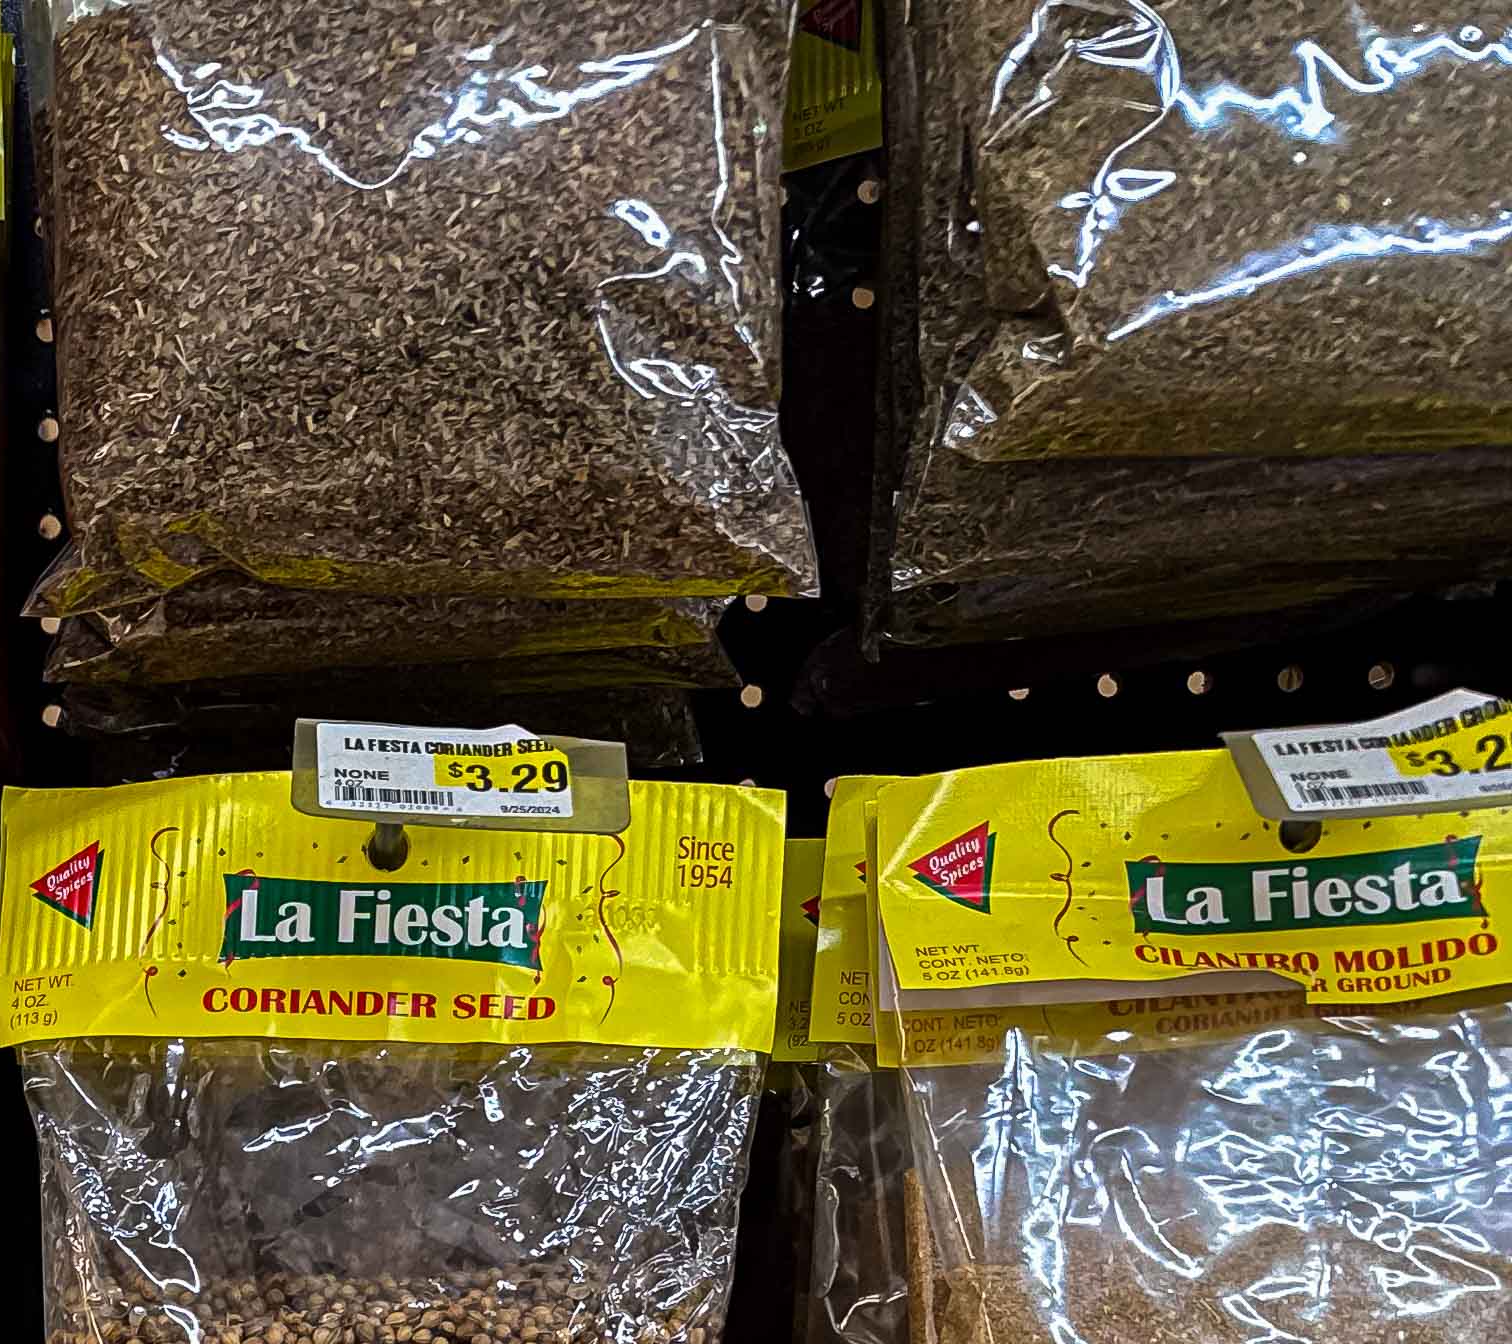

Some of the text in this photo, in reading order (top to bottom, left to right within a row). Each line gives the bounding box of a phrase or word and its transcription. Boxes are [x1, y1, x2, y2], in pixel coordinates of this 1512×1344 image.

[334, 767, 390, 781] NONE
[448, 760, 569, 795] $3.29
[678, 836, 735, 861] Since
[928, 837, 981, 875] Quality
[677, 864, 733, 888] 1954
[938, 856, 985, 887] Spices
[1145, 861, 1468, 925] La Fiesta
[239, 889, 528, 949] La Fiesta
[1134, 933, 1499, 977] CILANTRO MOLIDO
[1337, 967, 1453, 994] GROUND
[201, 987, 556, 1020] CORIANDER SEED
